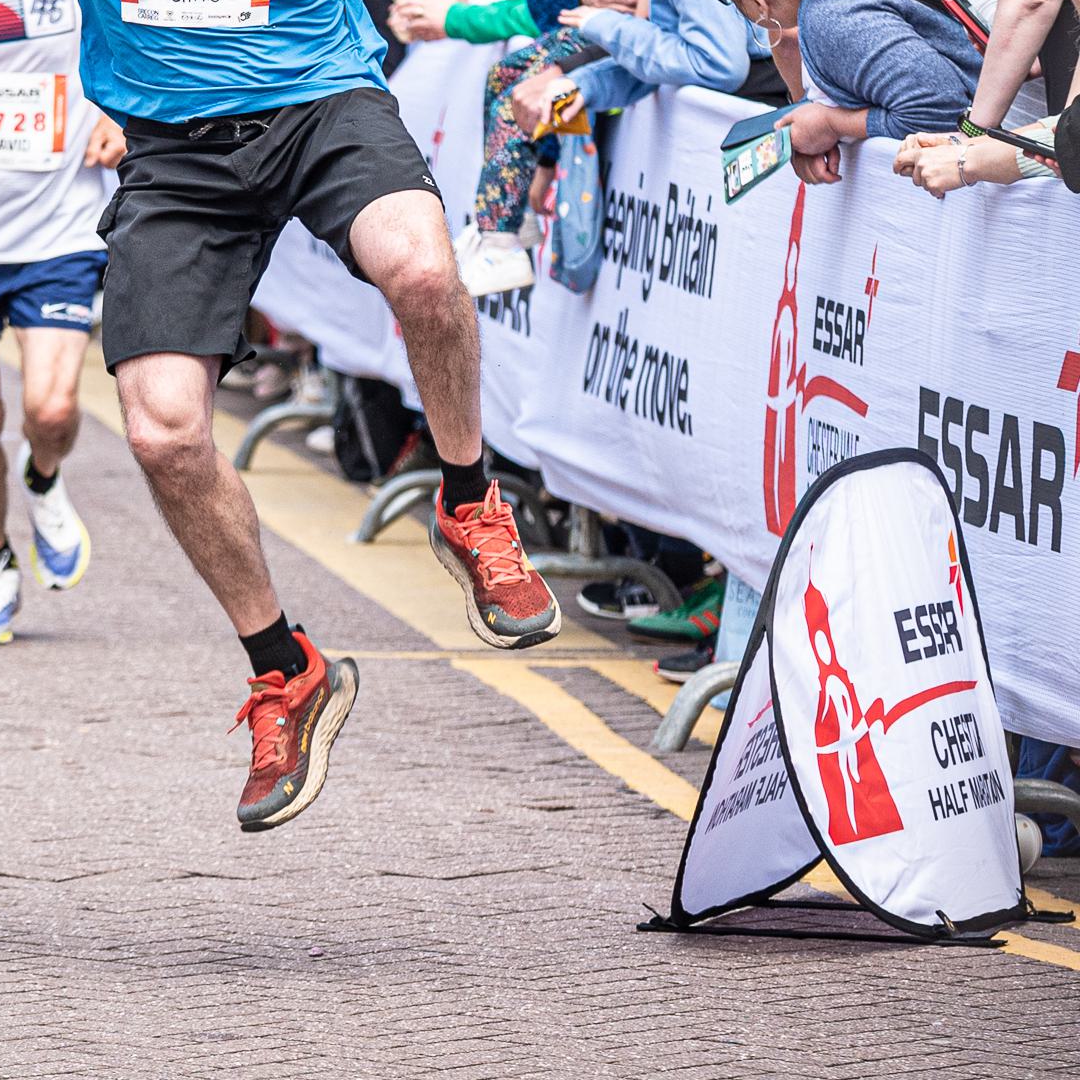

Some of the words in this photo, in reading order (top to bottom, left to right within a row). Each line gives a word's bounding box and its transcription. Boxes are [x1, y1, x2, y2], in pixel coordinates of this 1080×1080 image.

[604, 170, 661, 303] eeping
[659, 181, 718, 300] Britain
[583, 321, 611, 398] on
[606, 307, 640, 412] the
[634, 344, 693, 437] move.
[813, 295, 866, 367] ESSAR
[918, 385, 1066, 554] ESSAR
[928, 780, 968, 821] HALF
